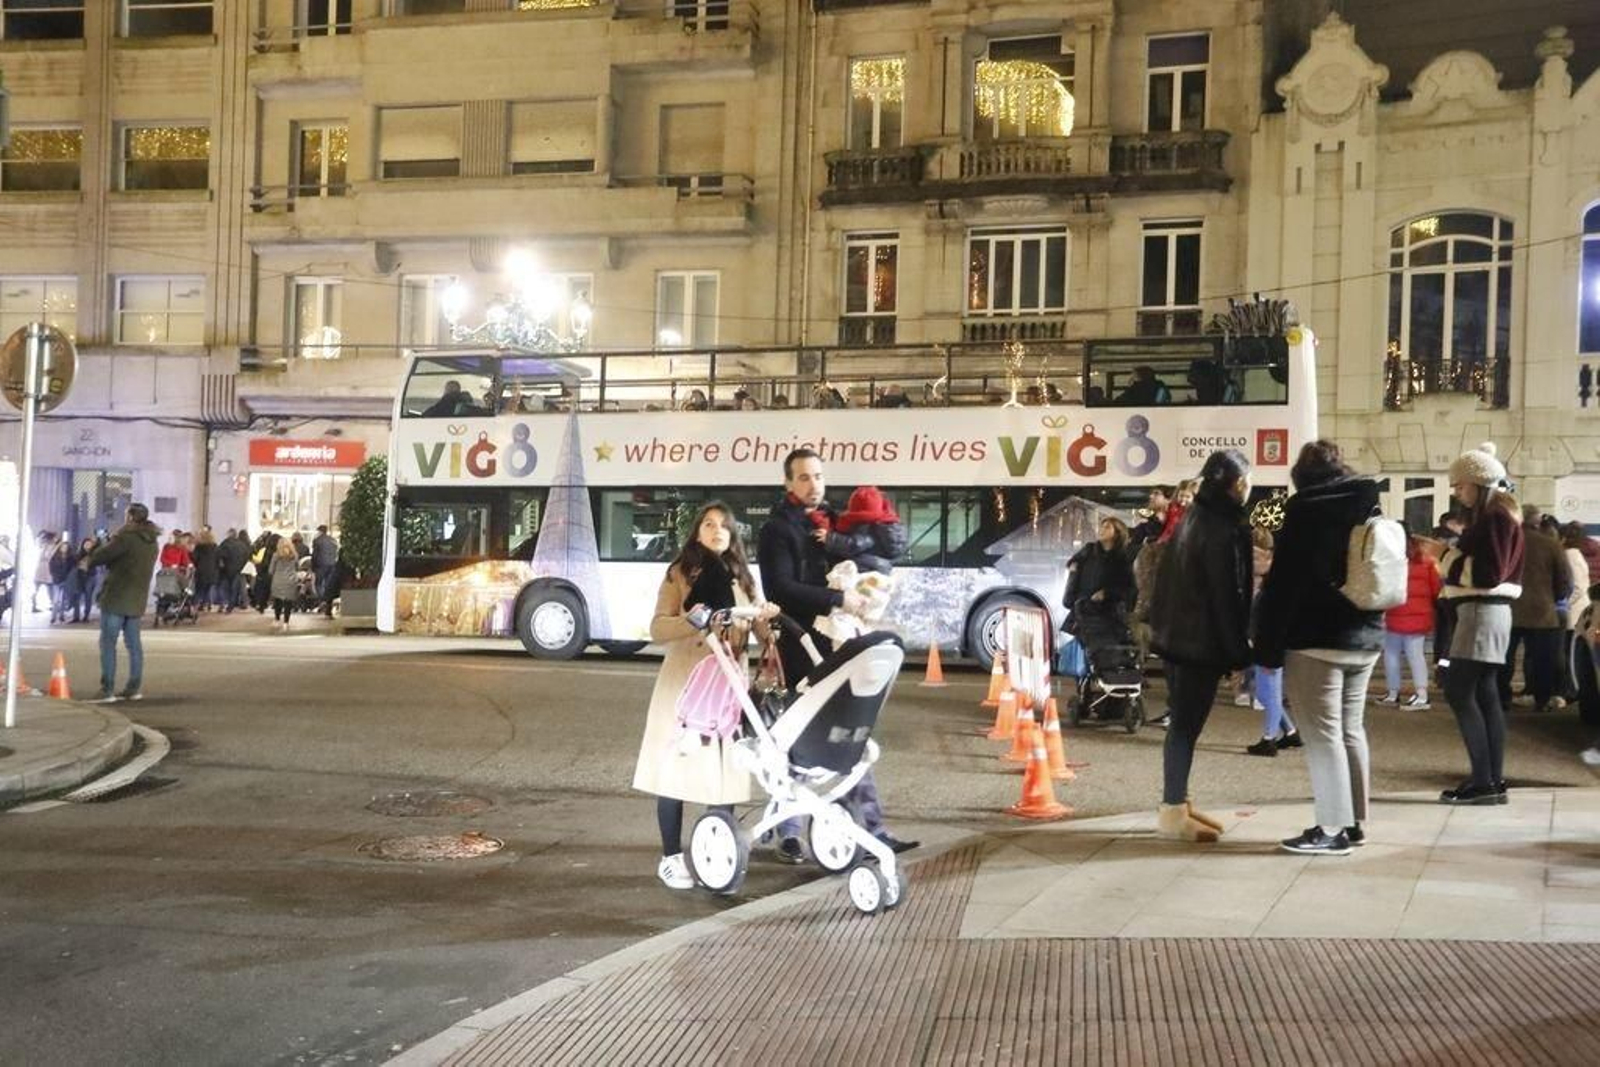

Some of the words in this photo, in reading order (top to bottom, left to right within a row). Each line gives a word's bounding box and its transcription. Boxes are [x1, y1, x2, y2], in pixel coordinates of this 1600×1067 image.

[1182, 436, 1248, 447] CONCELLO
[624, 437, 720, 463] where
[910, 433, 987, 462] lives
[1189, 448, 1206, 458] DE
